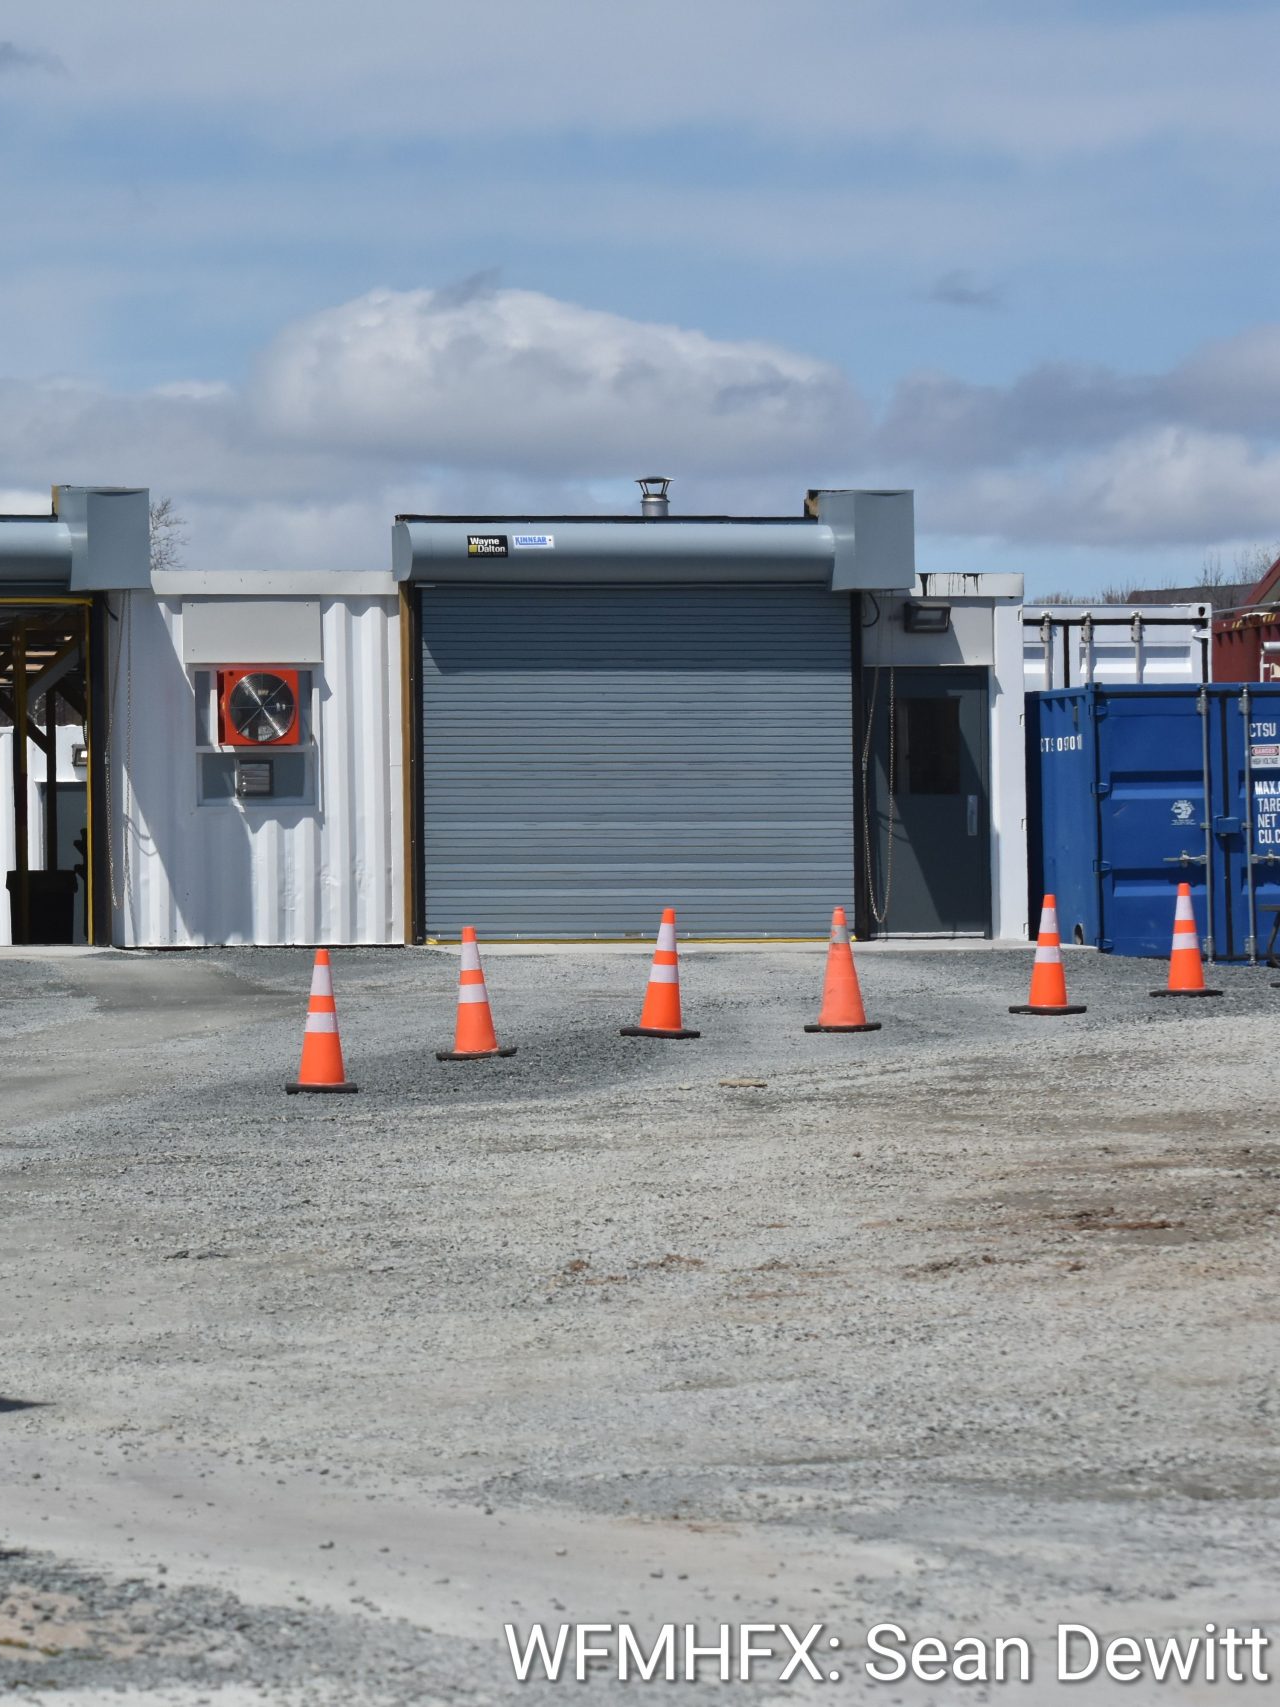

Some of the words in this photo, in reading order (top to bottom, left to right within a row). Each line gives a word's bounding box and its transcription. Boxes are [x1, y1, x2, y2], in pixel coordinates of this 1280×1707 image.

[470, 537, 500, 546] Wayne
[515, 536, 547, 545] KINNEAR
[477, 545, 506, 553] Dalton
[1258, 814, 1277, 828] NET
